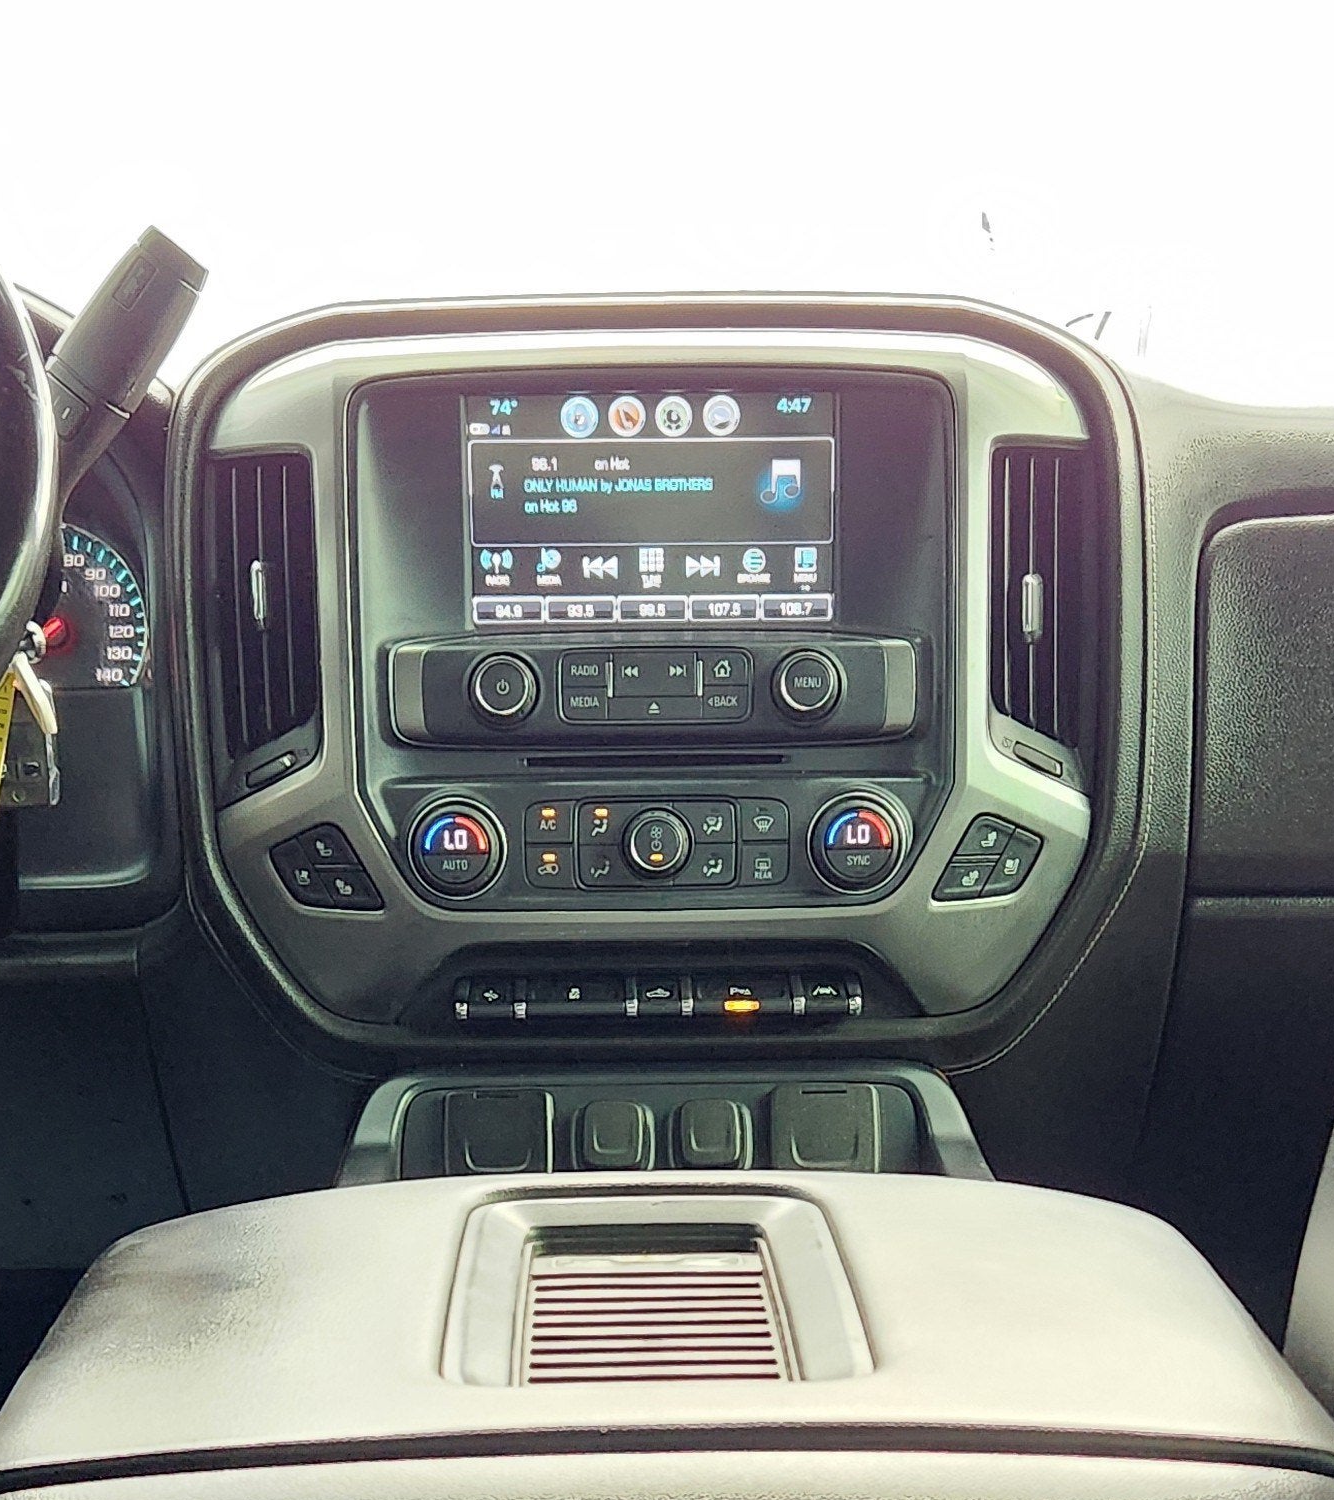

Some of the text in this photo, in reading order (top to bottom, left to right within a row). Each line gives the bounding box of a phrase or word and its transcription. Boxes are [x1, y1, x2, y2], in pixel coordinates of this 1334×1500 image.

[776, 396, 812, 413] 4:47
[609, 455, 631, 471] Hot
[523, 476, 714, 495] ONLY HUMAN by JONAS BROTHERS
[524, 501, 539, 514] on
[540, 498, 560, 514] Hot
[63, 553, 85, 568] 80
[84, 568, 107, 581] 90
[94, 584, 121, 598] 100
[108, 603, 131, 618] 110
[108, 624, 135, 639] 120
[106, 646, 133, 661] 130
[95, 667, 124, 683] 140
[570, 665, 599, 676] RADIO
[793, 676, 822, 689] MENU
[570, 696, 600, 708] MEDIA
[713, 696, 738, 707] BACK
[539, 819, 558, 831] A/C
[846, 824, 871, 844] LO
[442, 859, 469, 872] AUTO
[846, 854, 871, 867] SYNC
[754, 870, 773, 880] REAR
